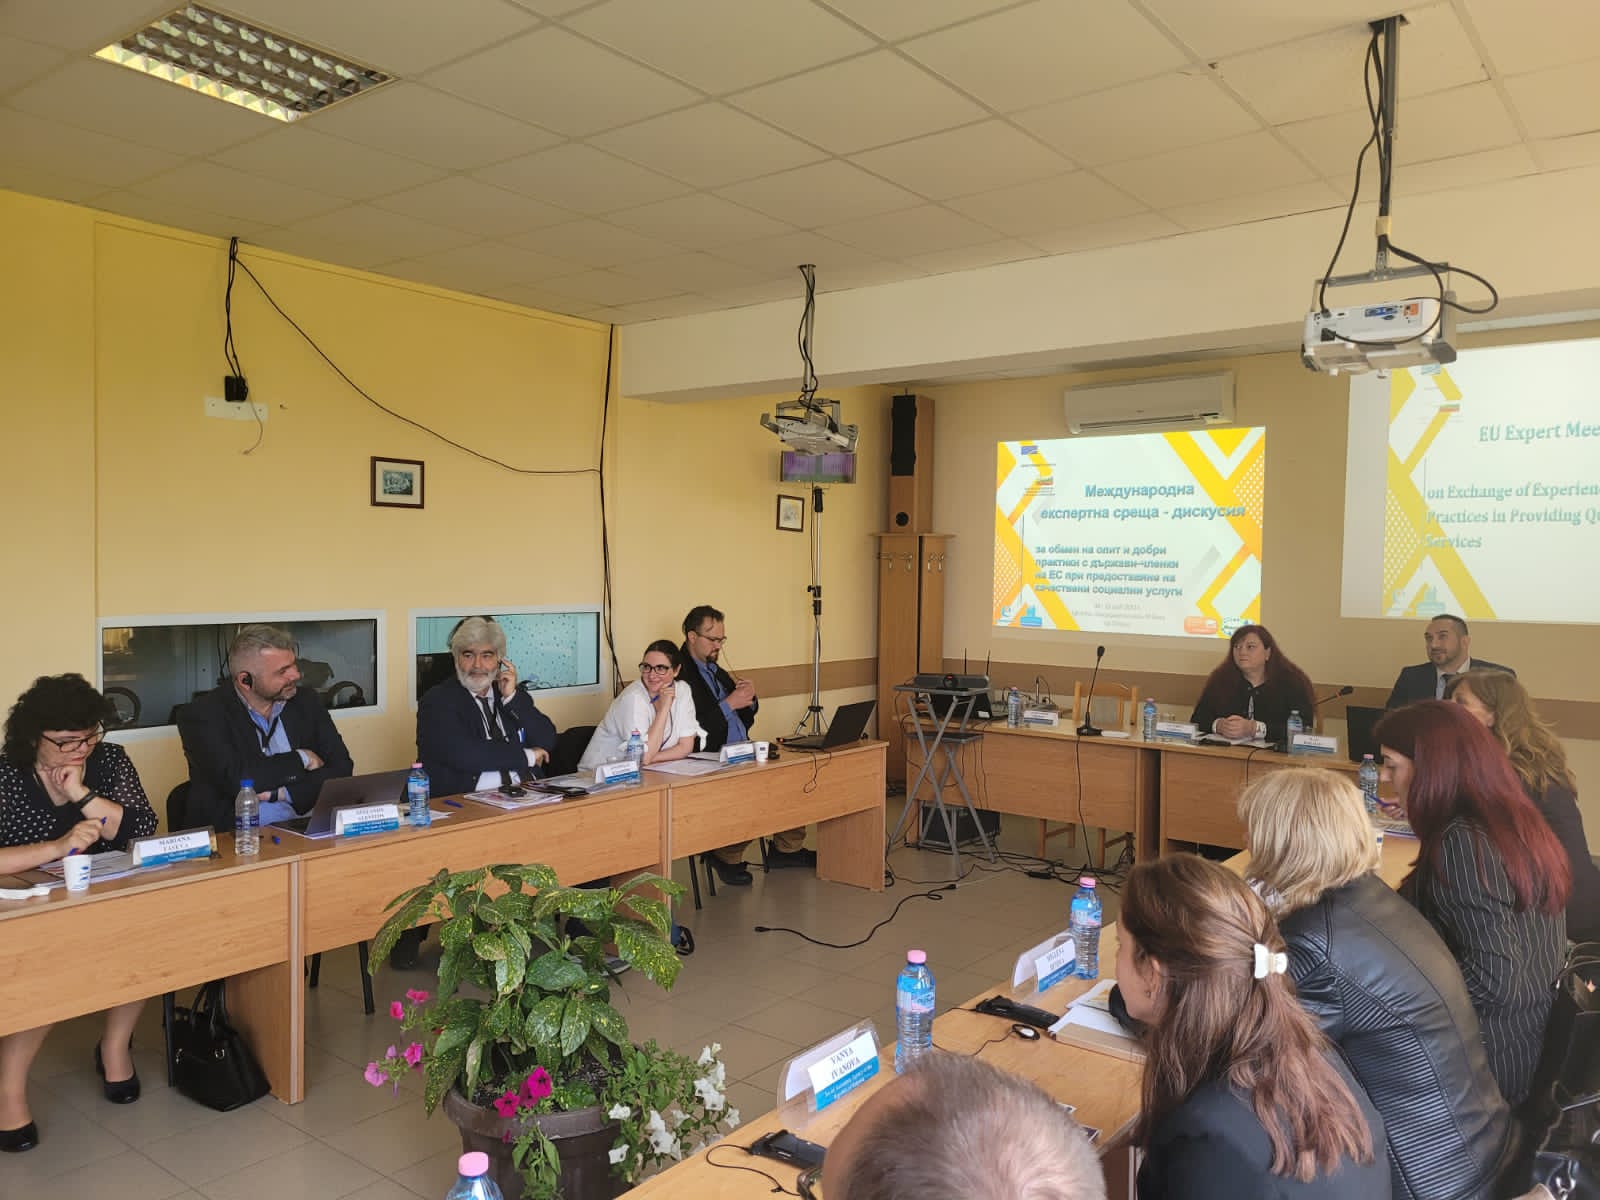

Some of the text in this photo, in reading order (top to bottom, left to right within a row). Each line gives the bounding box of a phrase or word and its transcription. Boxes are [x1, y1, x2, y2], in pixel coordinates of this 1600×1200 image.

[1479, 424, 1500, 442] EU
[1505, 423, 1561, 444] Expert
[1084, 484, 1195, 499] Международна
[1427, 480, 1600, 501] on Exchange of Experien
[1040, 506, 1110, 521] експертна
[1113, 506, 1159, 520] среща
[1171, 505, 1246, 520] дискусия
[1426, 509, 1489, 524] Practices
[1492, 507, 1506, 523] in
[1509, 506, 1581, 526] Providing
[1425, 532, 1482, 549] Services
[1082, 546, 1094, 554] на
[1096, 546, 1121, 554] опит
[1132, 544, 1167, 557] добри
[1082, 559, 1089, 567] с
[1048, 569, 1063, 579] ЕС
[1065, 572, 1084, 582] при
[1092, 585, 1143, 595] социални
[1145, 587, 1183, 598] услуги
[160, 836, 191, 845] MARIANA
[831, 1047, 855, 1064] VANYA
[831, 1056, 861, 1080] IVANOVA
